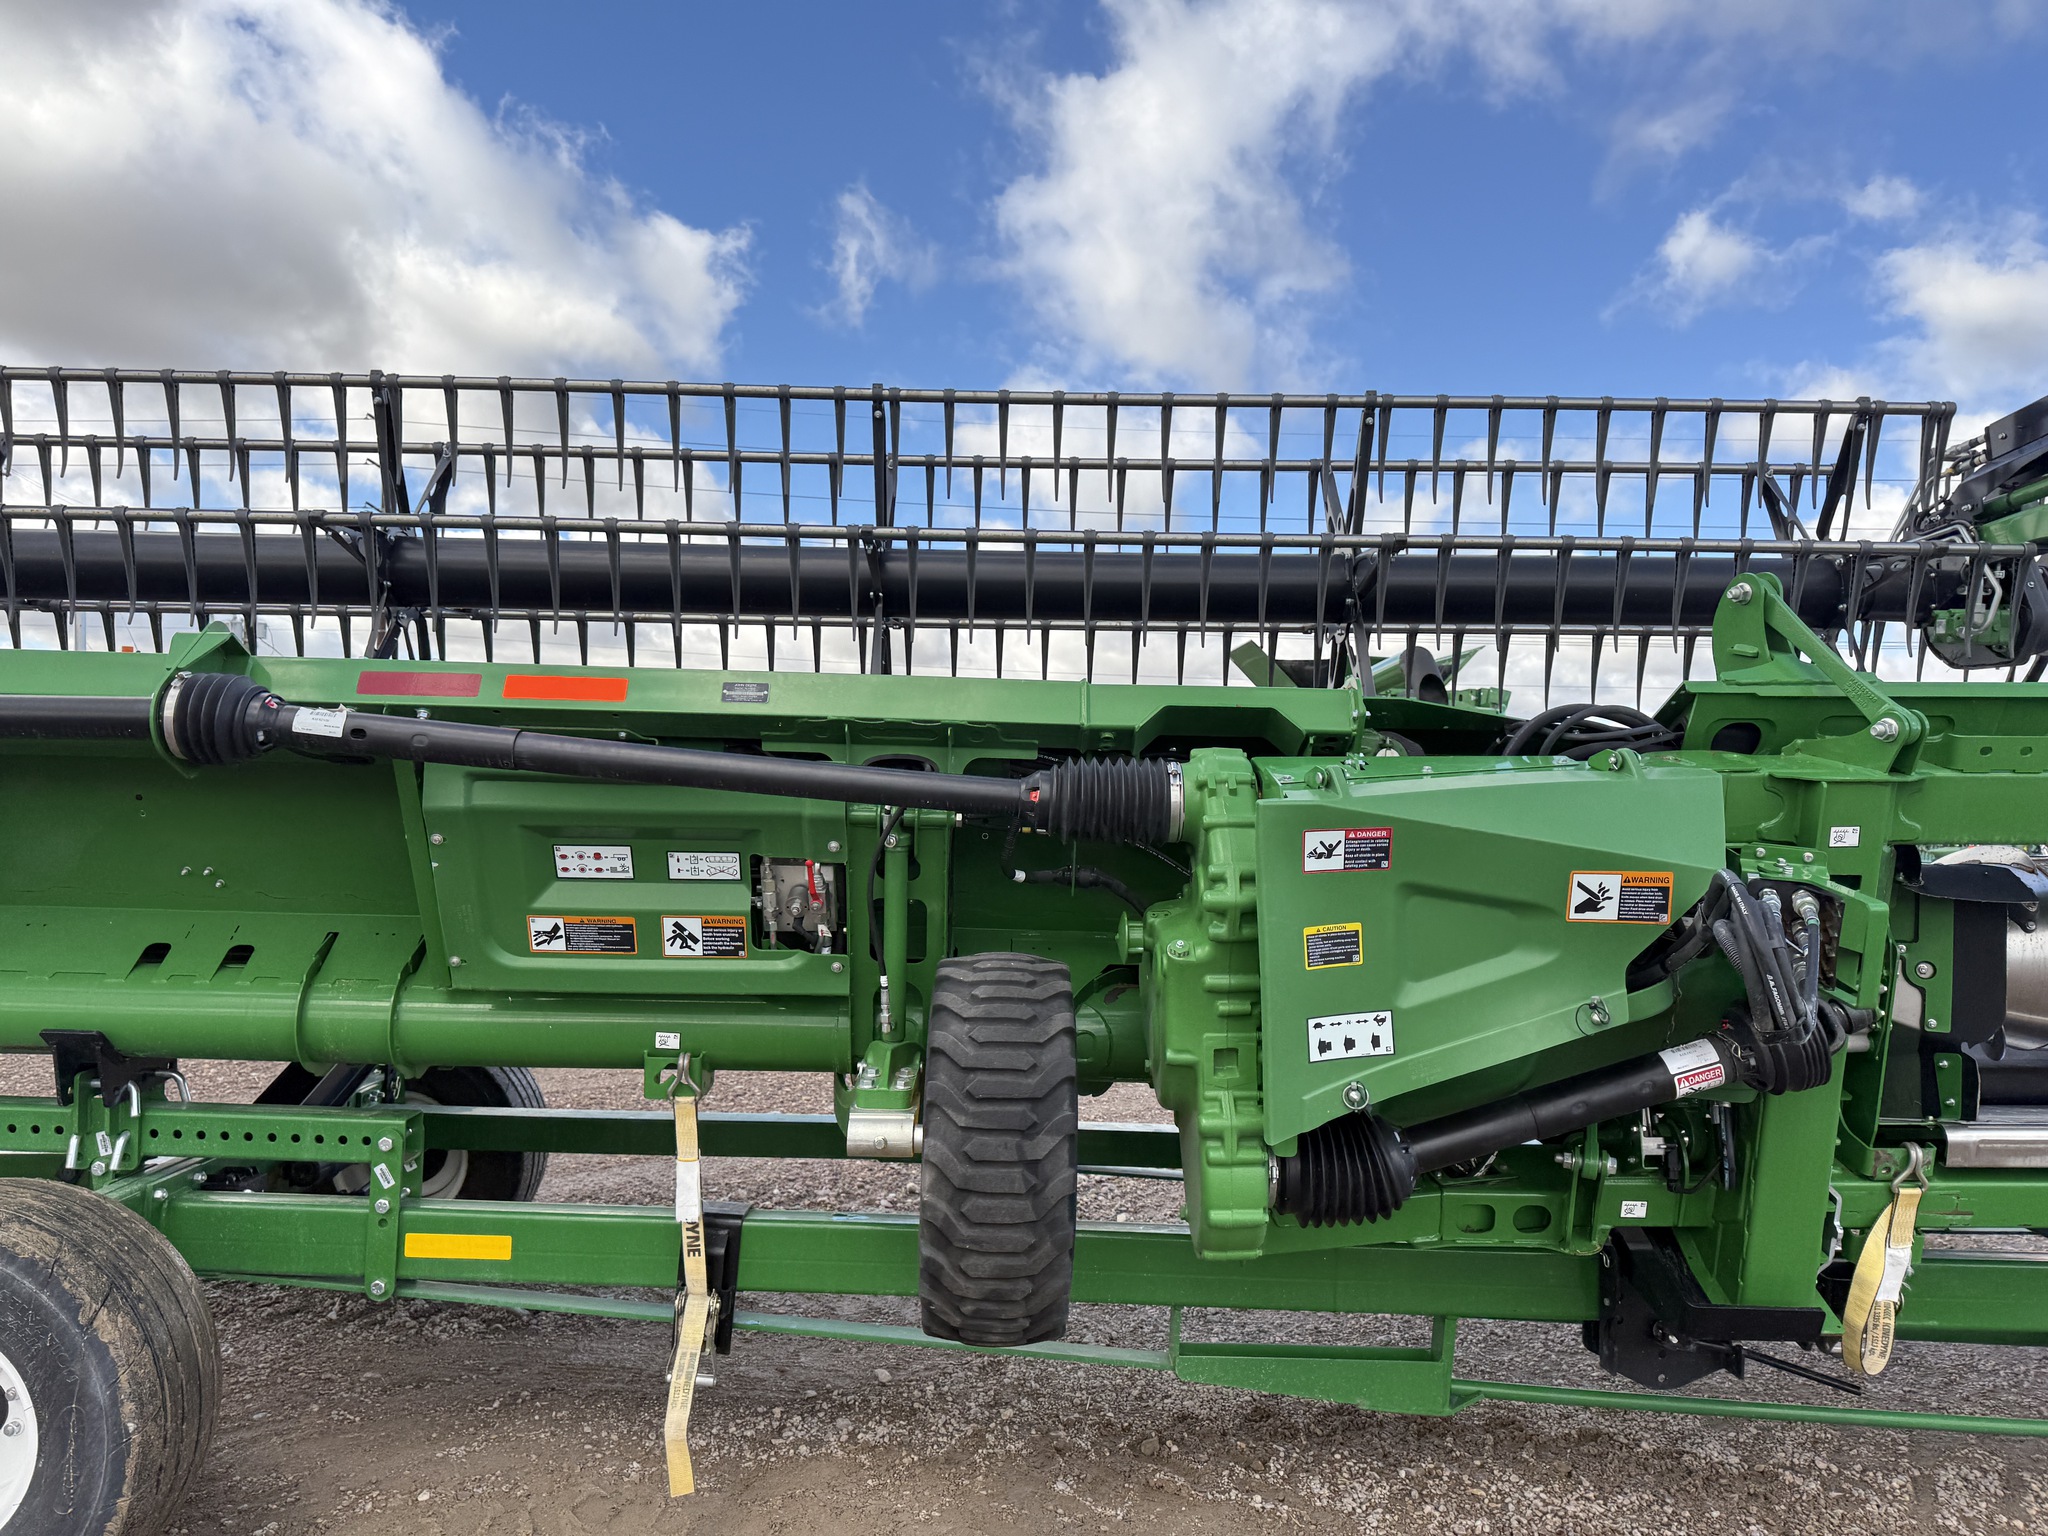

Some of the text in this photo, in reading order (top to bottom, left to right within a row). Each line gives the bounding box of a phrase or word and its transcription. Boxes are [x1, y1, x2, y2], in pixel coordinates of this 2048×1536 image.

[1631, 876, 1670, 884] WARNING
[1688, 1069, 1722, 1085] DANGER
[1880, 1322, 1892, 1360] KINEDYNE
